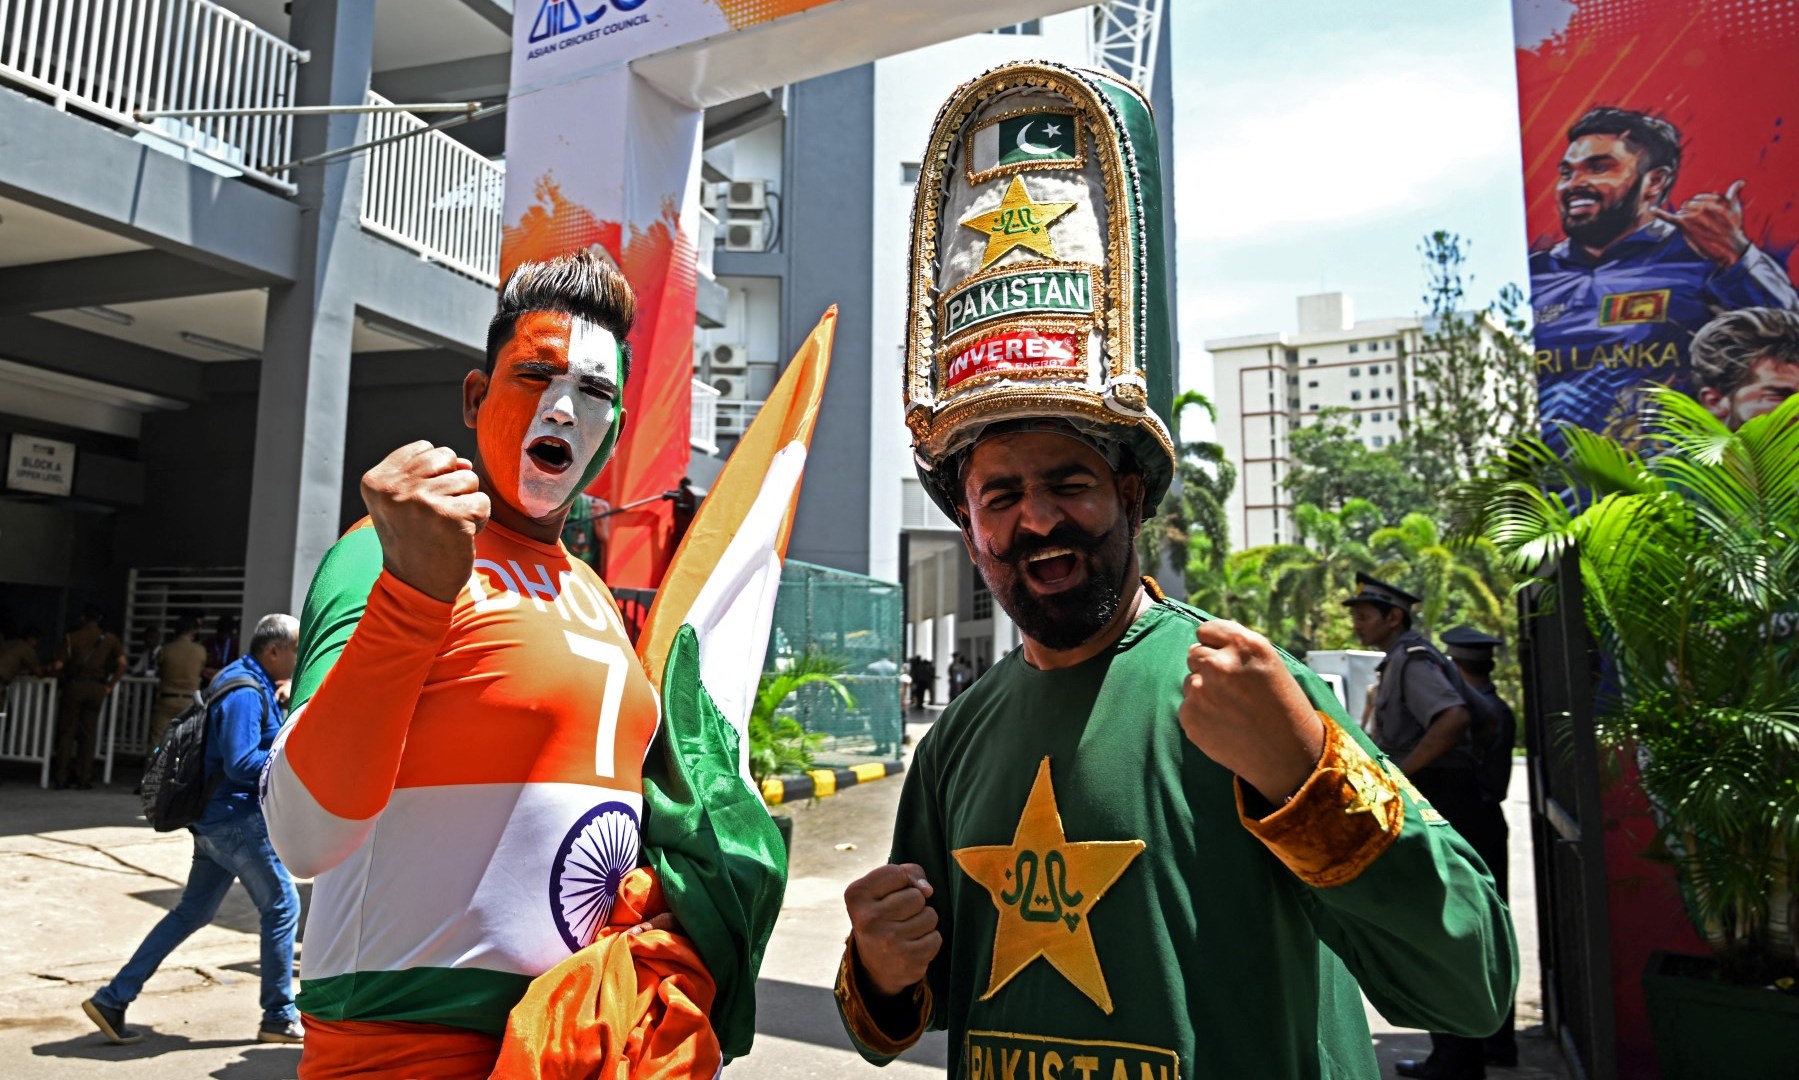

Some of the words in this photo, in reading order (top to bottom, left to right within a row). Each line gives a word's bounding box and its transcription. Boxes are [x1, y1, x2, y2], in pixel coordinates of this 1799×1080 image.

[527, 43, 557, 60] ASIAN
[559, 29, 601, 50] CRICKET
[603, 14, 650, 36] COUNCIL
[949, 277, 1085, 331] PAKISTAN
[948, 338, 1064, 379] INVEREX
[1535, 349, 1561, 374] RI
[1571, 342, 1680, 370] LANKA
[16, 469, 41, 479] UPPER
[42, 473, 64, 483] LEVEL
[22, 457, 53, 470] BLOCK
[55, 462, 62, 471] A
[563, 630, 629, 778] 7
